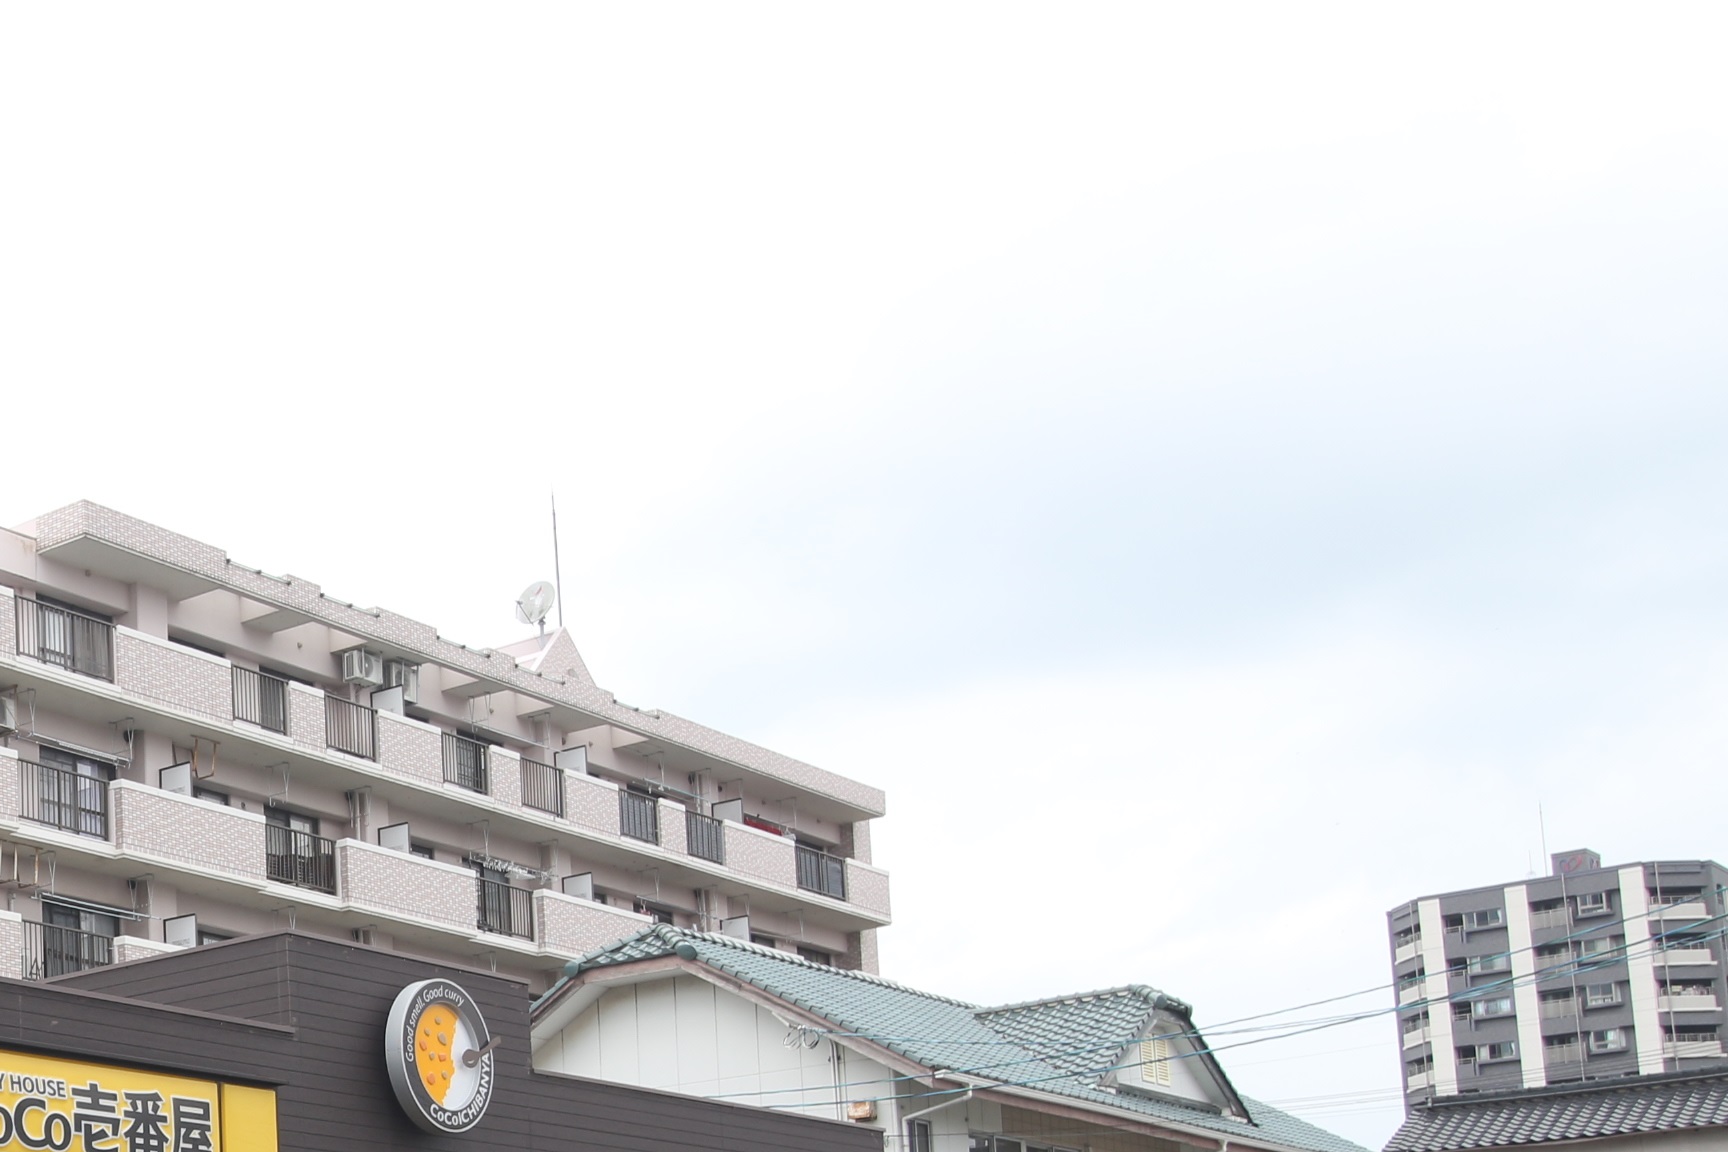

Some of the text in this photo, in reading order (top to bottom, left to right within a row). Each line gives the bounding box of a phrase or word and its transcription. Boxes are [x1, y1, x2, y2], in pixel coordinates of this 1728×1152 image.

[405, 1025, 414, 1062] Good
[423, 985, 443, 1002] Good
[444, 989, 464, 1007] curry
[9, 1074, 67, 1098] HOUSE
[430, 1052, 490, 1126] CoCoICHIBANYA
